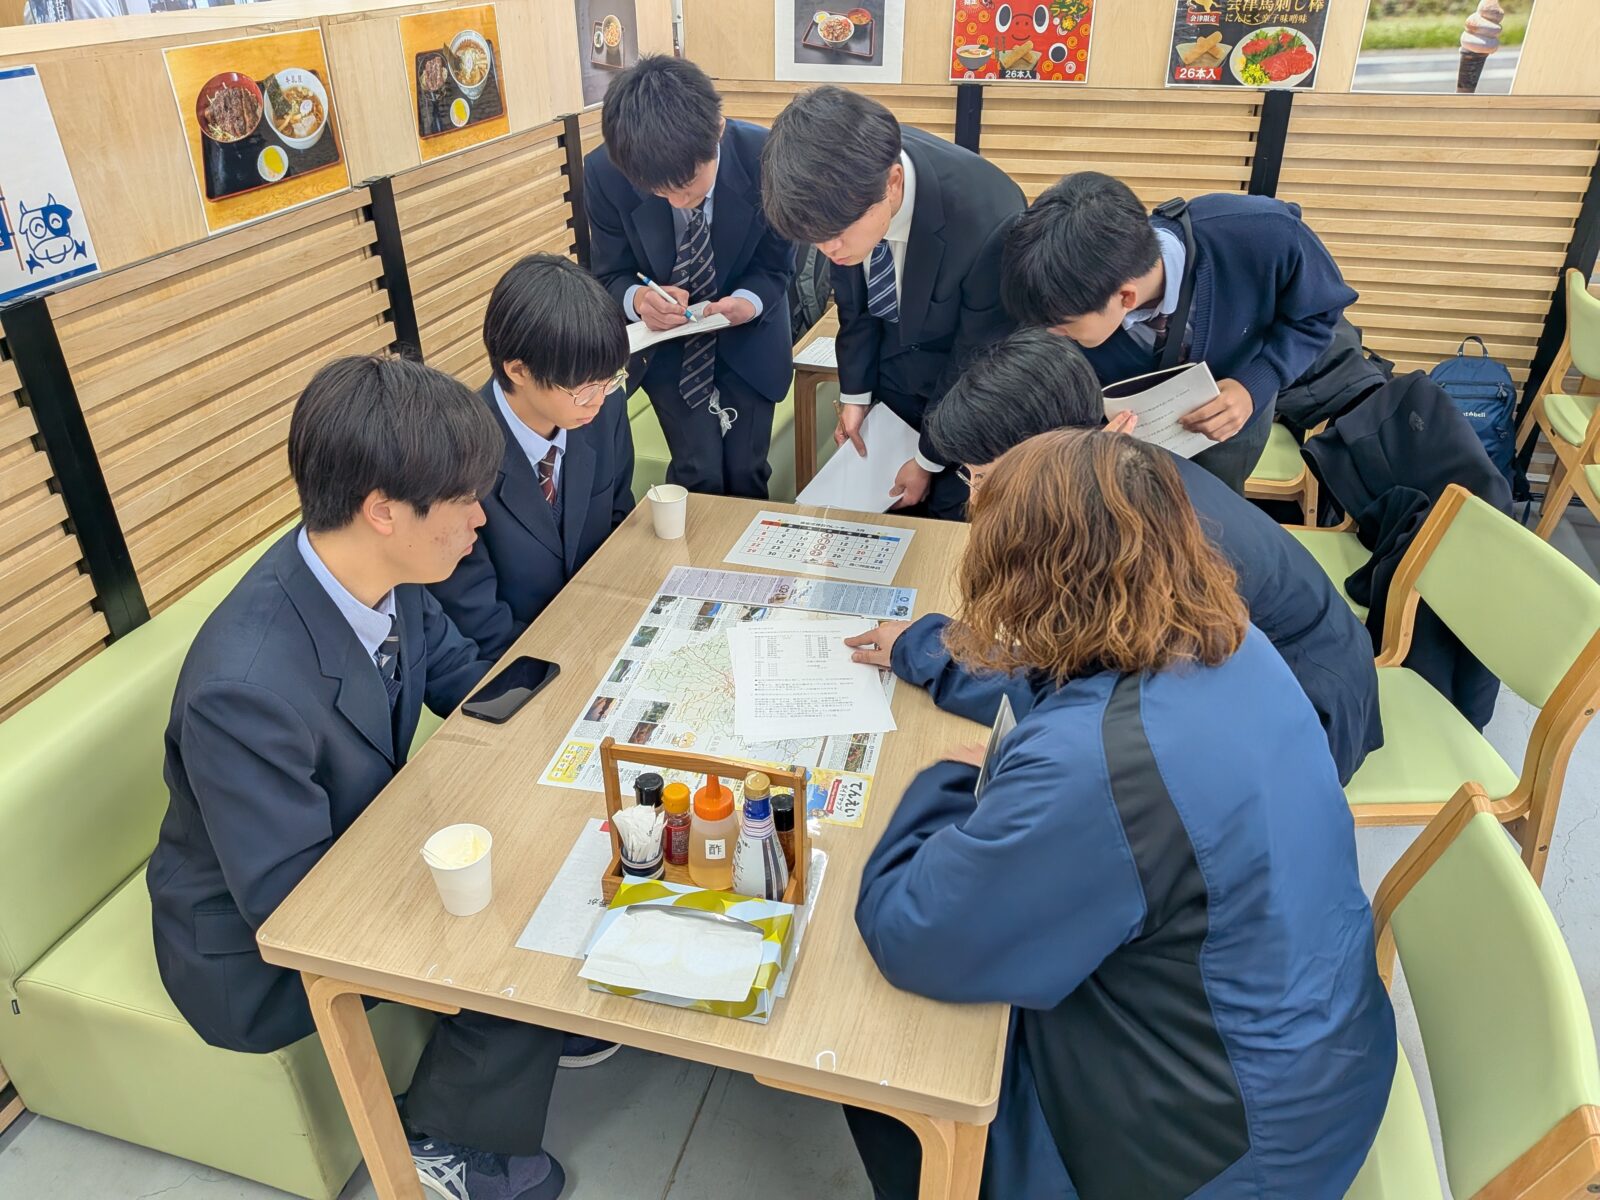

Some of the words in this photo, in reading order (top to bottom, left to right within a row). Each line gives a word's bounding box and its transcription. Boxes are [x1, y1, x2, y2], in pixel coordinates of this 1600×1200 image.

[1005, 70, 1032, 79] 26本入
[1179, 67, 1217, 80] 26本入
[708, 843, 722, 856] 酢
